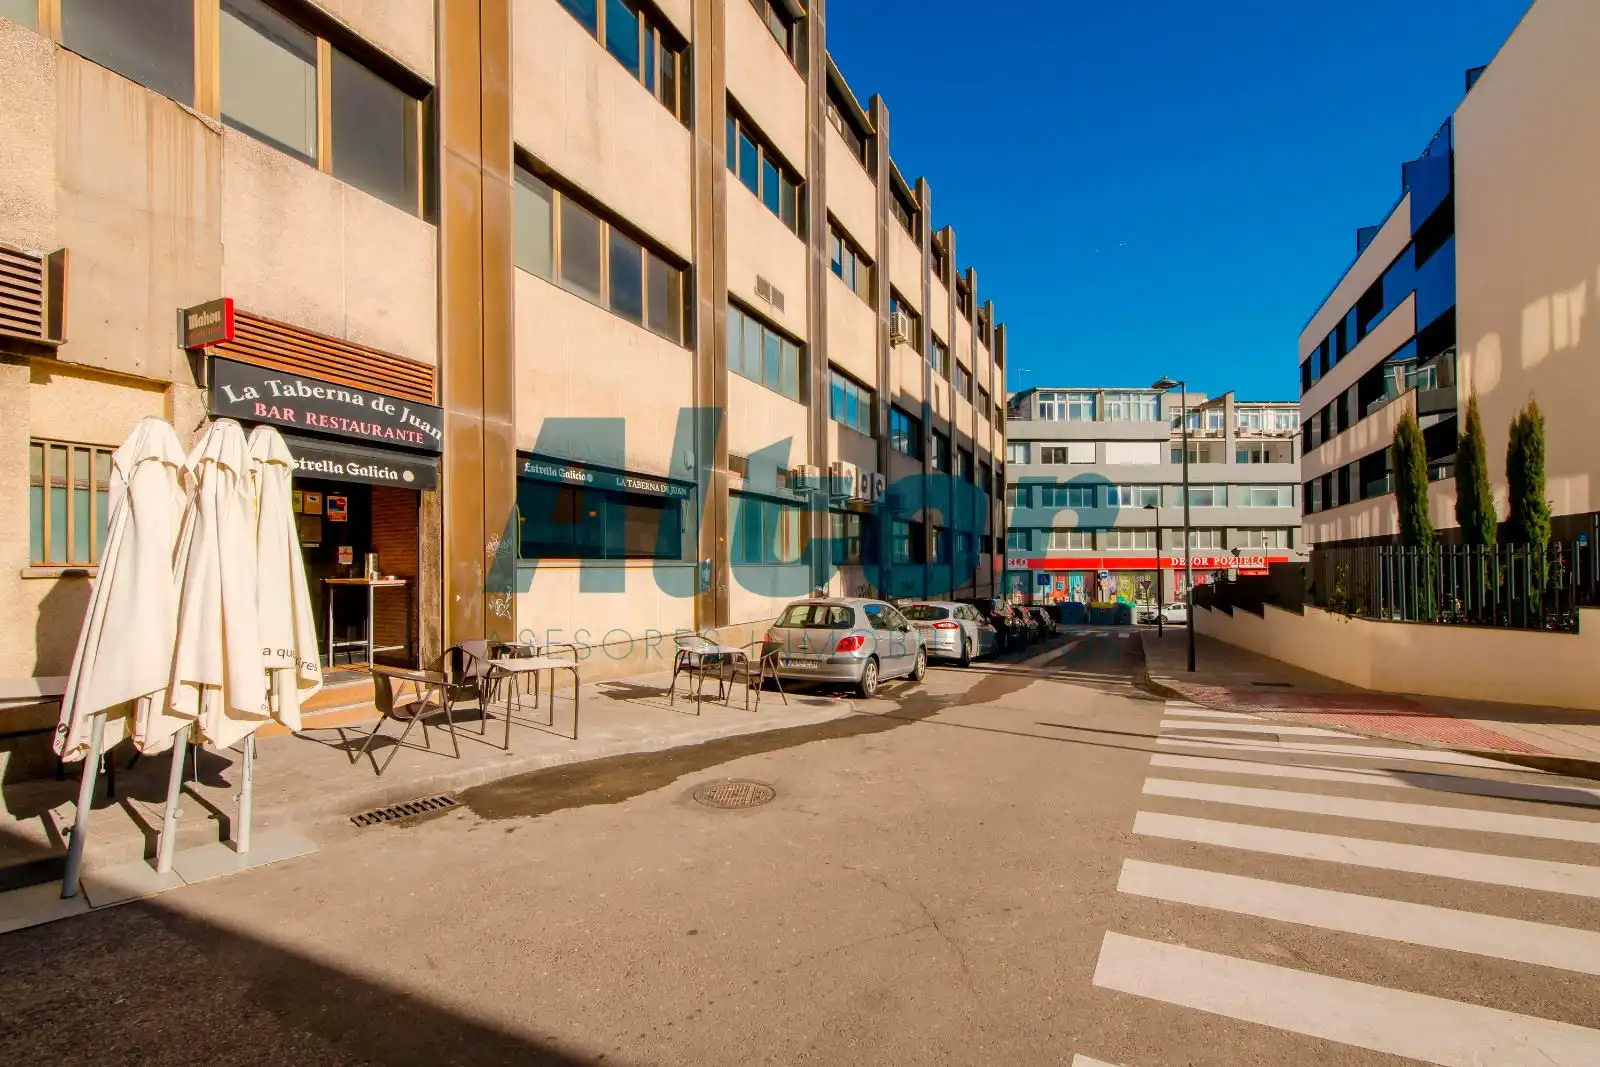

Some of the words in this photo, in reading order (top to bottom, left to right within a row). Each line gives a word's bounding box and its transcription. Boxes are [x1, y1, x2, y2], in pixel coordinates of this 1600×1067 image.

[221, 384, 260, 404] La
[264, 379, 365, 406] Taberna
[371, 397, 395, 416] de
[400, 407, 443, 441] Juan
[253, 402, 296, 423] BAR
[305, 411, 424, 445] RESTAURANTE
[291, 457, 344, 475] strella
[346, 462, 399, 480] Galicia
[524, 462, 557, 477] Estrella
[558, 467, 587, 481] Galicia
[616, 477, 626, 487] LA
[626, 479, 660, 492] TABERNA
[660, 484, 670, 493] DE
[670, 485, 687, 496] JUAN
[1171, 557, 1209, 566] DEOR
[1214, 556, 1265, 566] POZUELO
